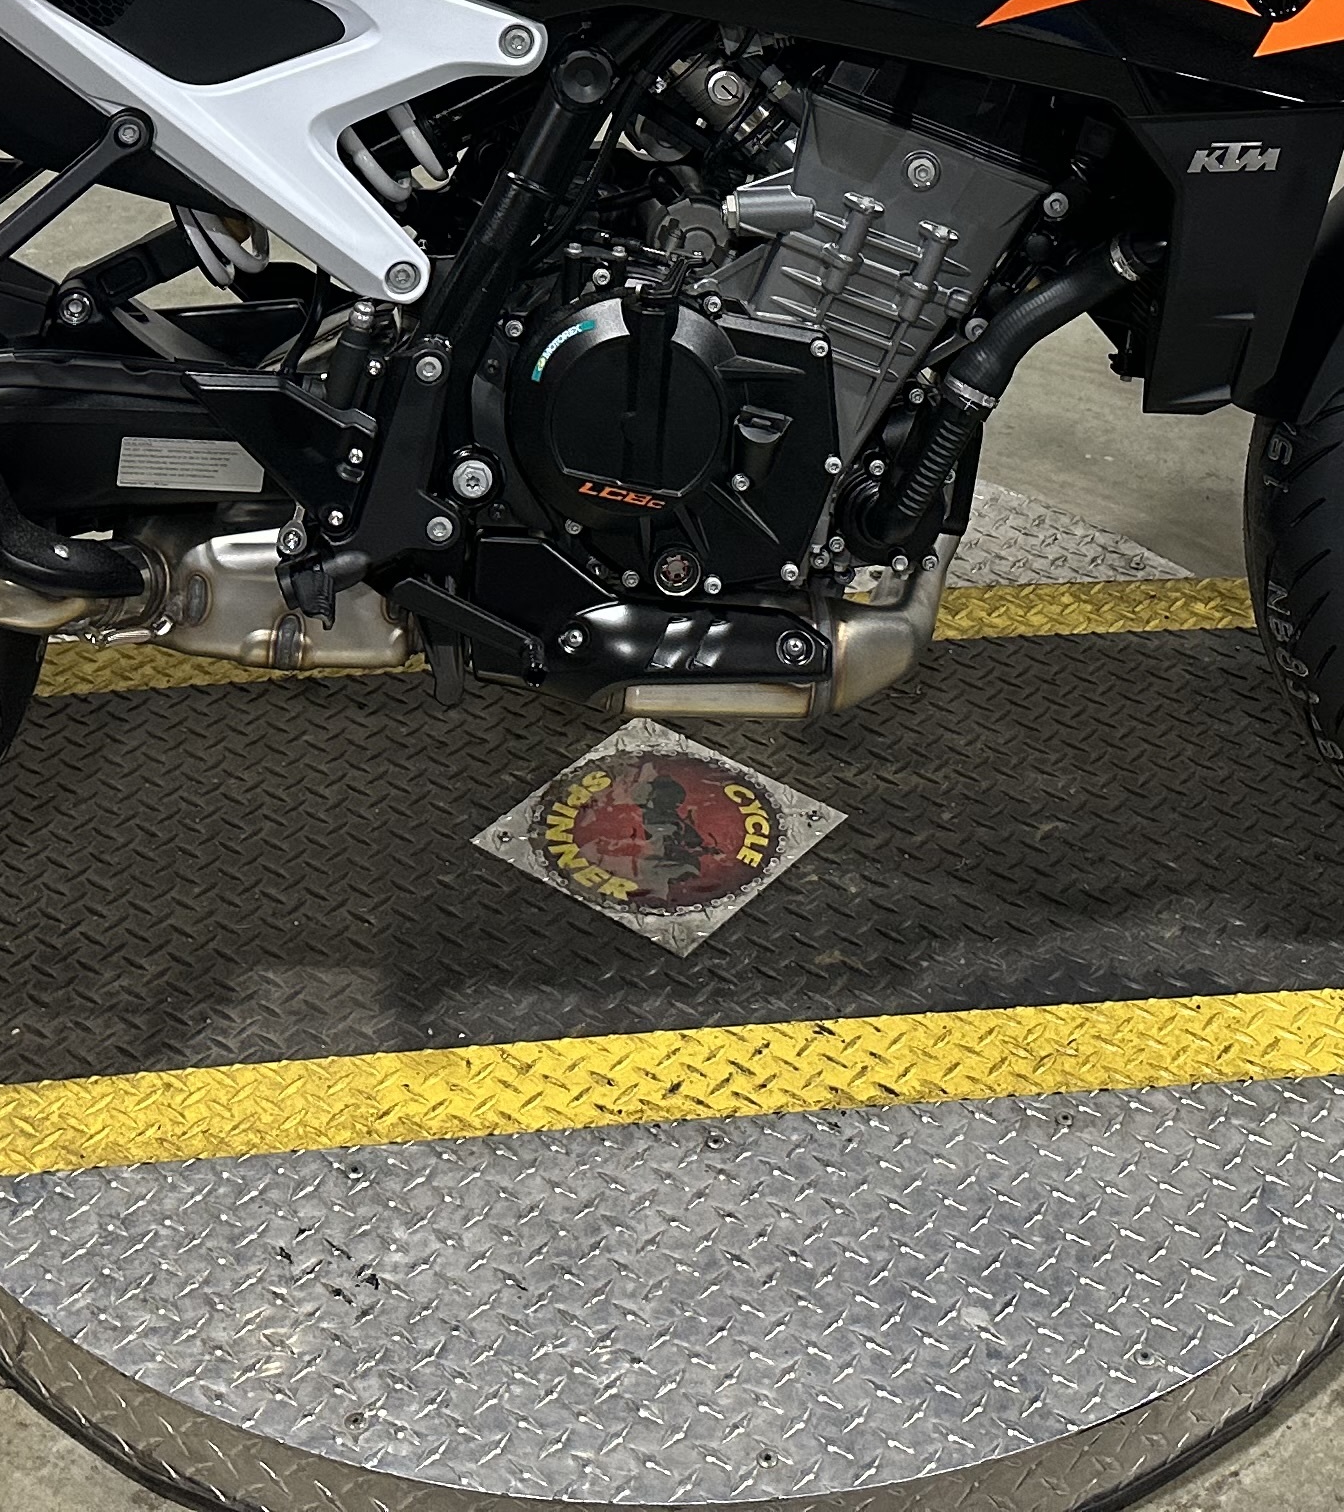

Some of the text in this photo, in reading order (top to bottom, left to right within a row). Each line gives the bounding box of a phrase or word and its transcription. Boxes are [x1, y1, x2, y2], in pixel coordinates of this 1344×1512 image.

[1187, 141, 1280, 173] KTM
[542, 324, 583, 360] MOTOREX
[545, 770, 639, 901] SPINNER
[723, 782, 772, 868] CYCLE
